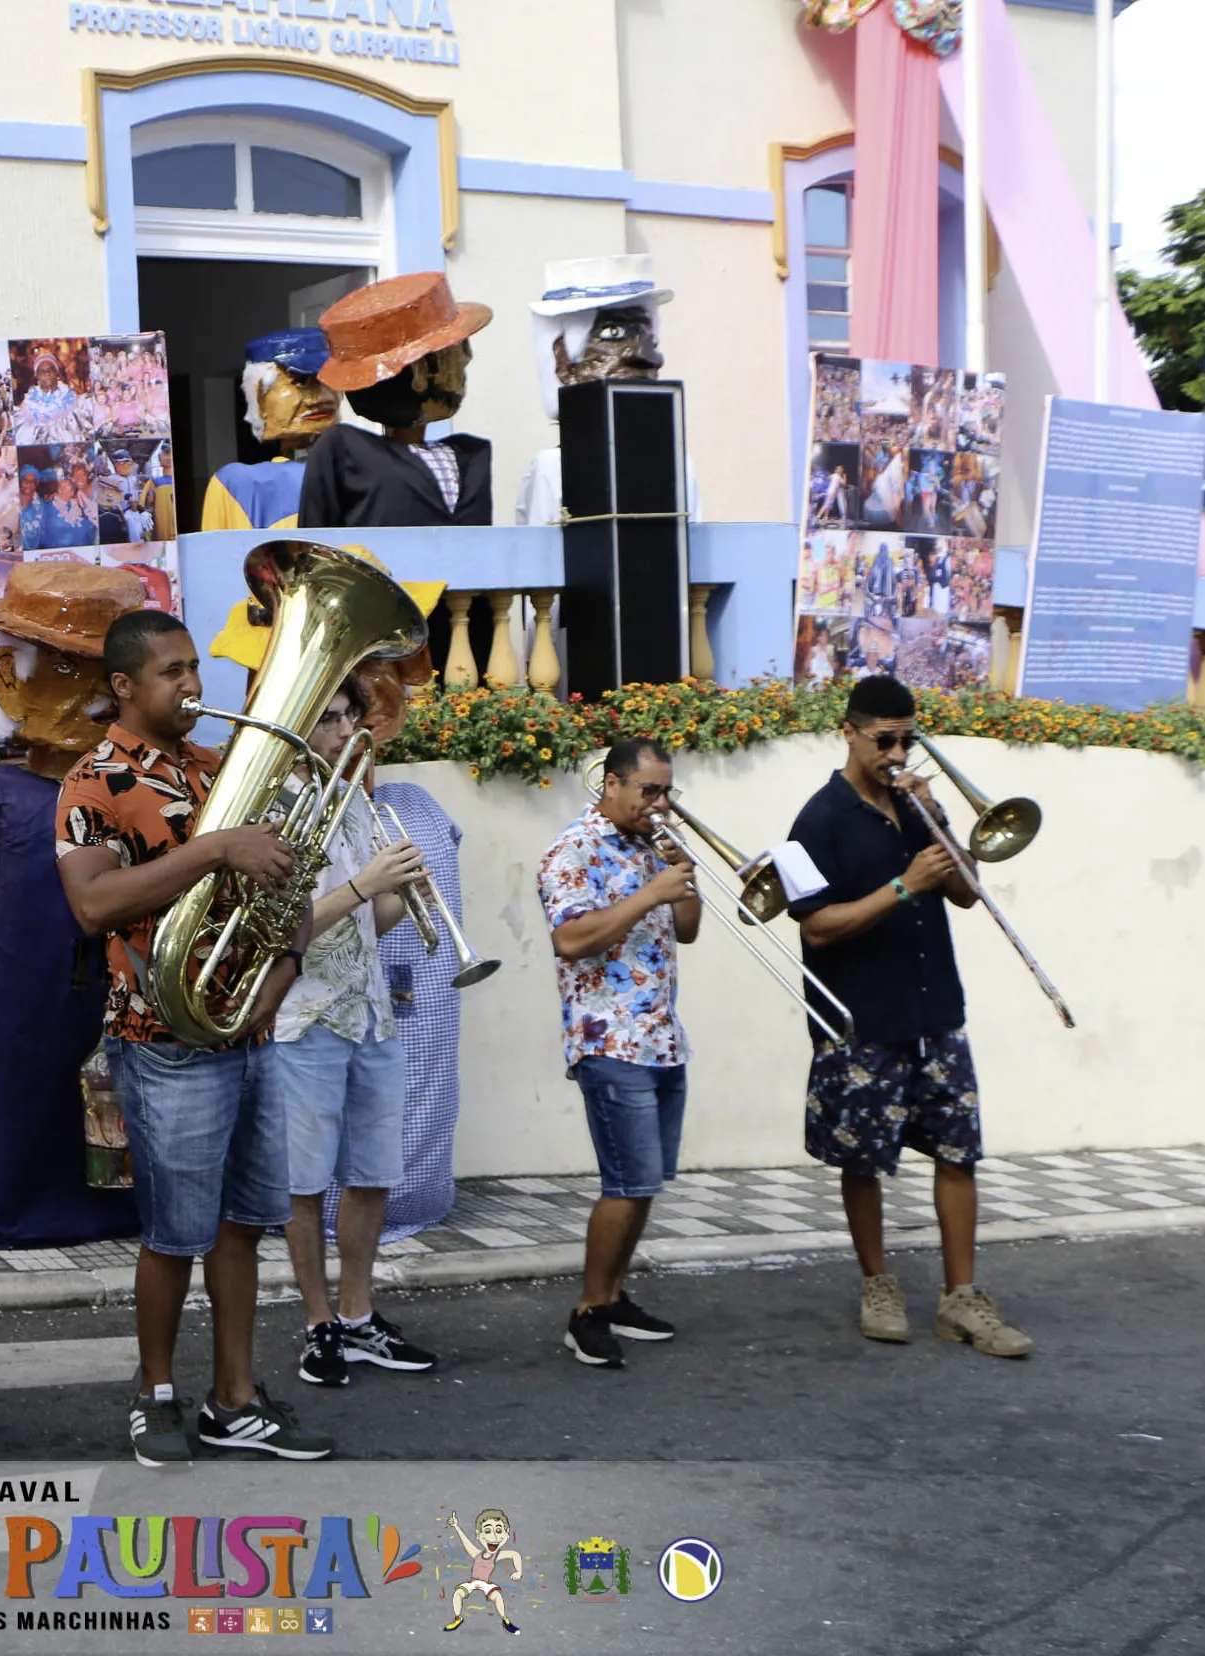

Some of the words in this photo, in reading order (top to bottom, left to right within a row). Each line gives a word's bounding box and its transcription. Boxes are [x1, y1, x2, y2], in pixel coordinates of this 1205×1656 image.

[69, 4, 224, 43] PROFESSOR
[232, 18, 321, 53] LICÍNIO
[330, 28, 460, 67] CARPINELLI
